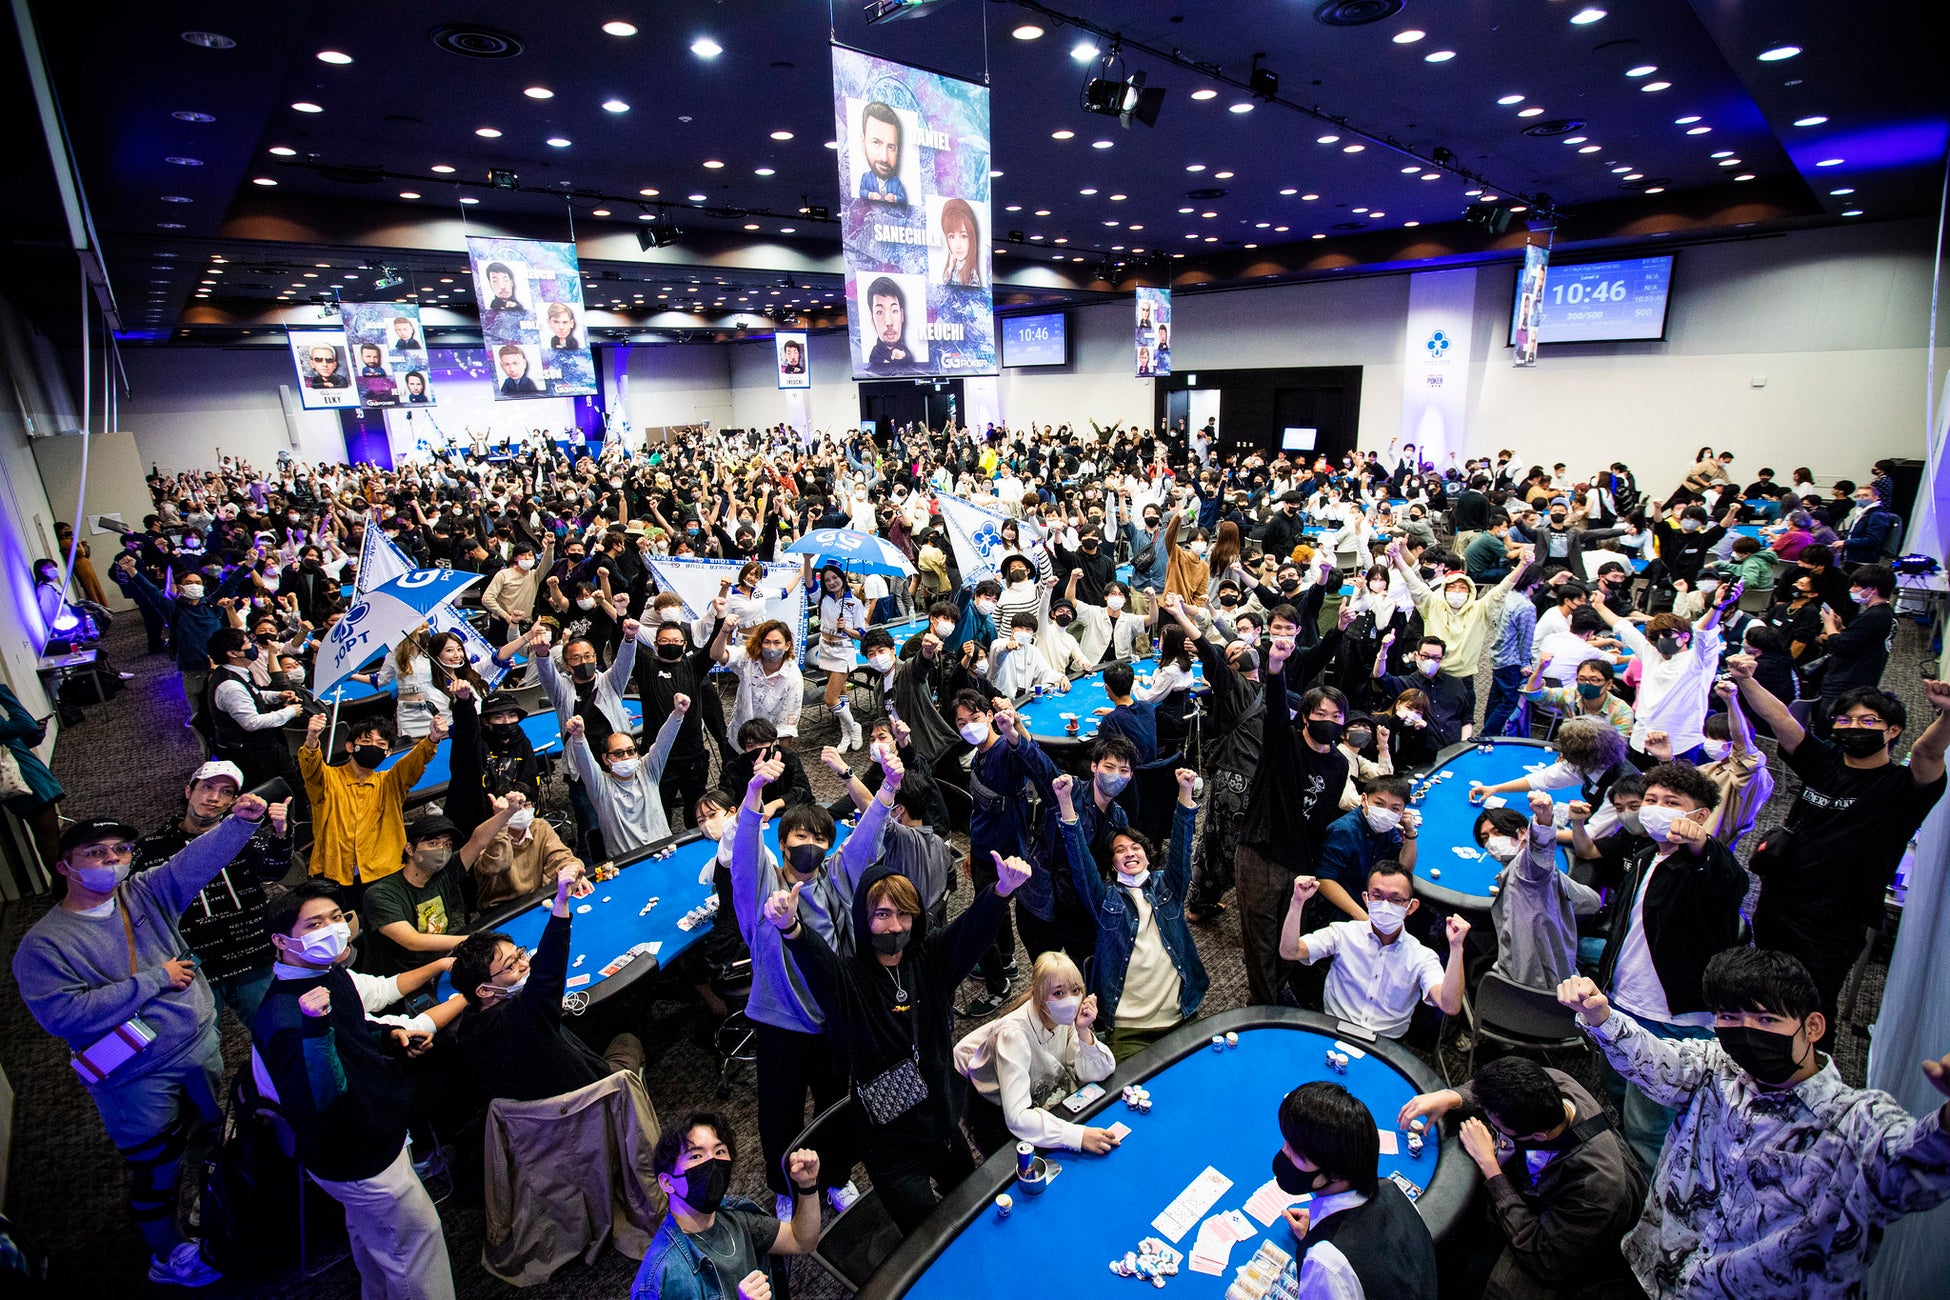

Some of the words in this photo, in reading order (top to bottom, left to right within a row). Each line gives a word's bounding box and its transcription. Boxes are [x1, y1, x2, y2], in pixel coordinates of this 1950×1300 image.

[1552, 280, 1627, 305] 10:46
[1019, 327, 1049, 343] 10:46
[324, 395, 342, 404] ELKY
[334, 630, 370, 668] JOPT
[222, 965, 253, 978] MADAME
